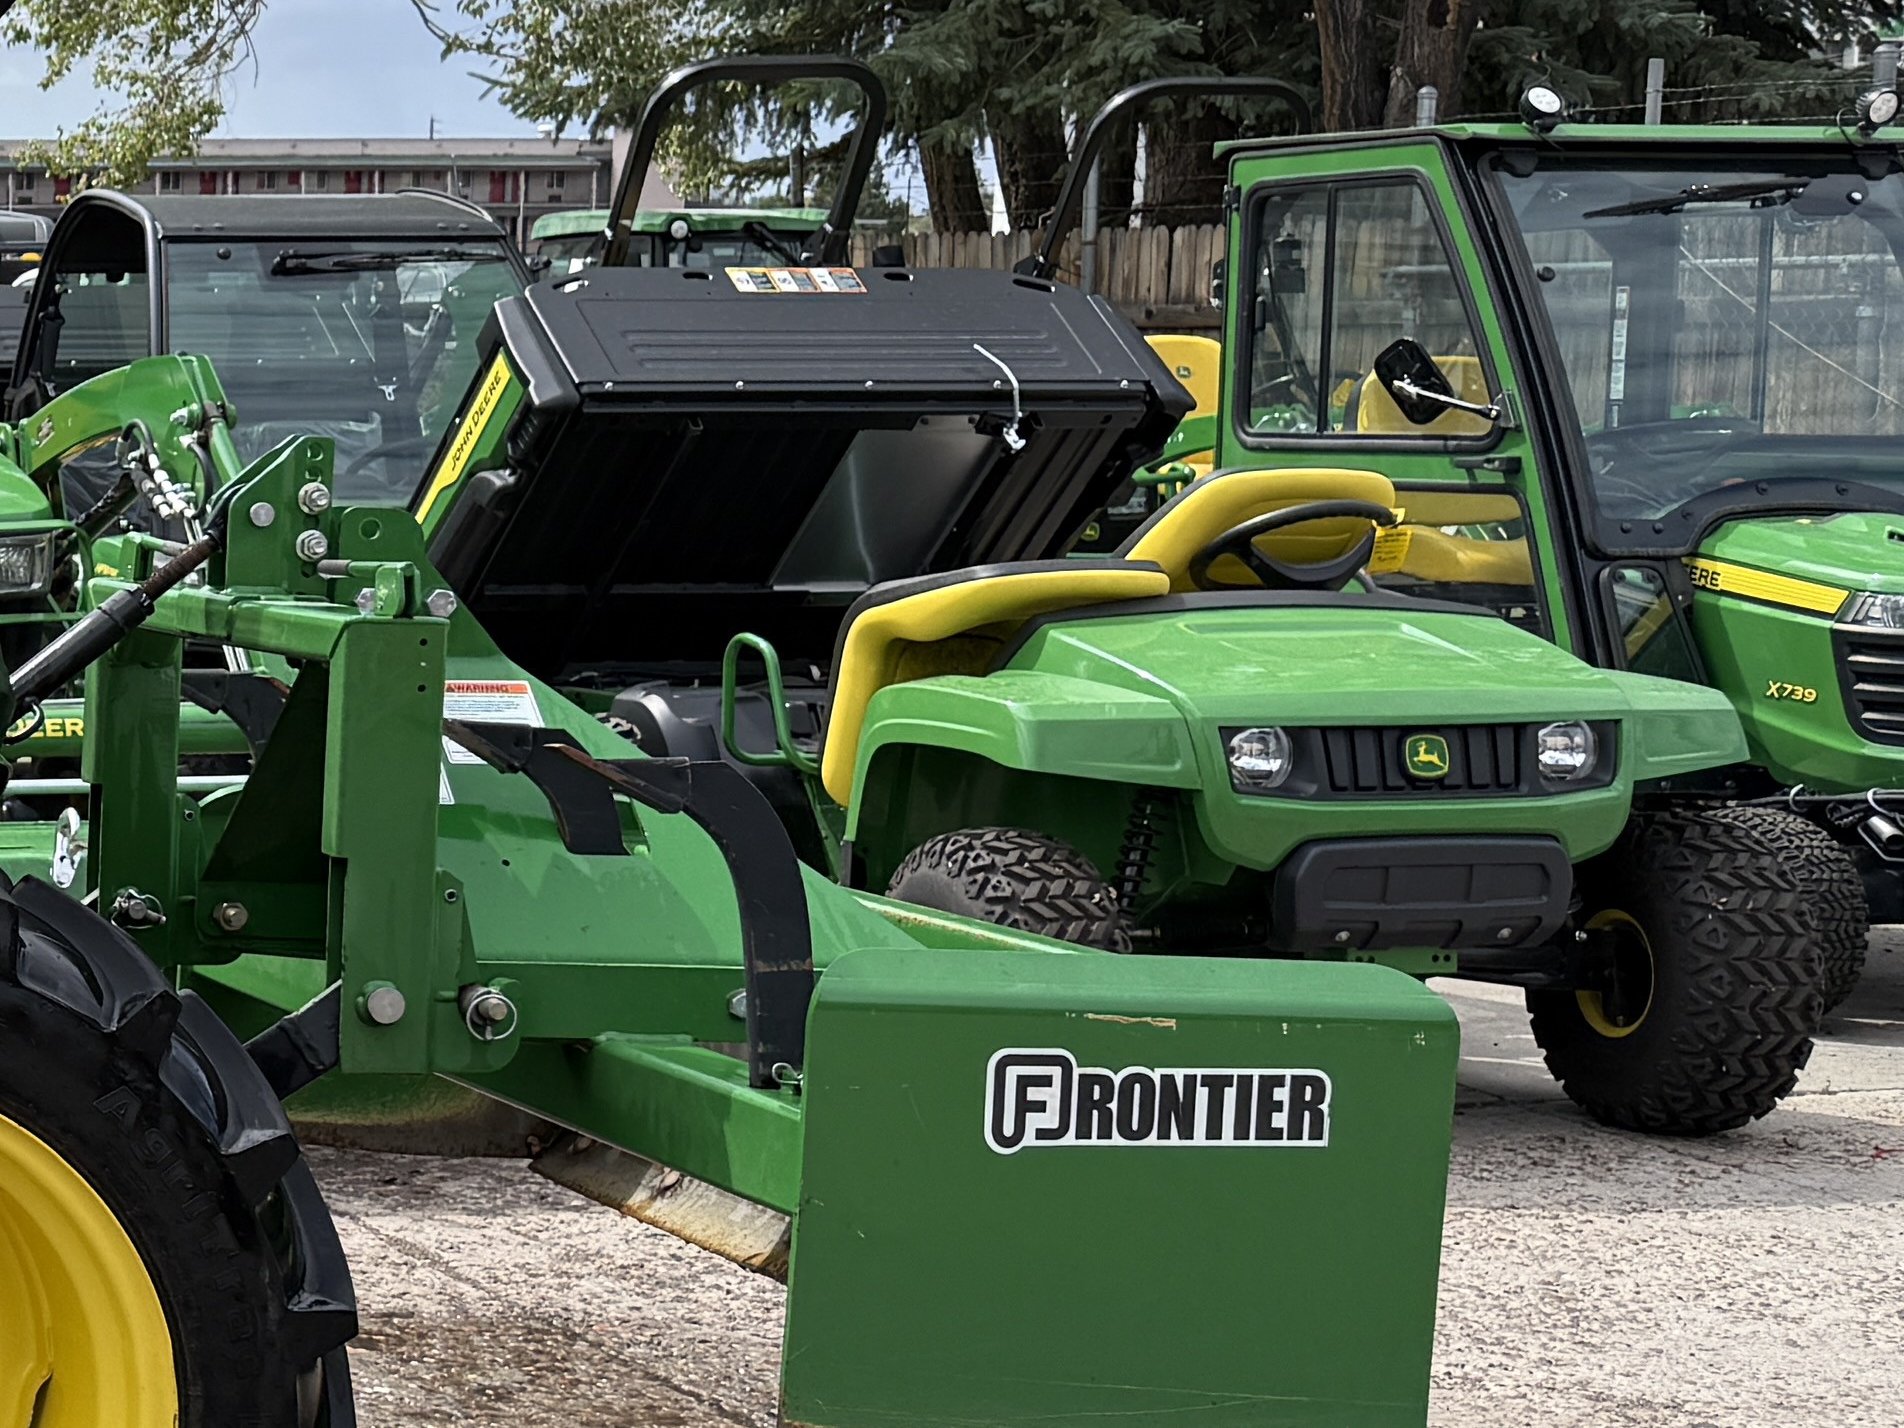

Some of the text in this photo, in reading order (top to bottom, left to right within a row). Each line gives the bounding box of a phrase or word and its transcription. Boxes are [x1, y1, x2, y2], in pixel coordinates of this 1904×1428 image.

[452, 370, 502, 472] JOHN DEERE
[1688, 564, 1722, 588] ERE
[1765, 679, 1817, 703] X739
[989, 1052, 1329, 1150] FRONTIER
